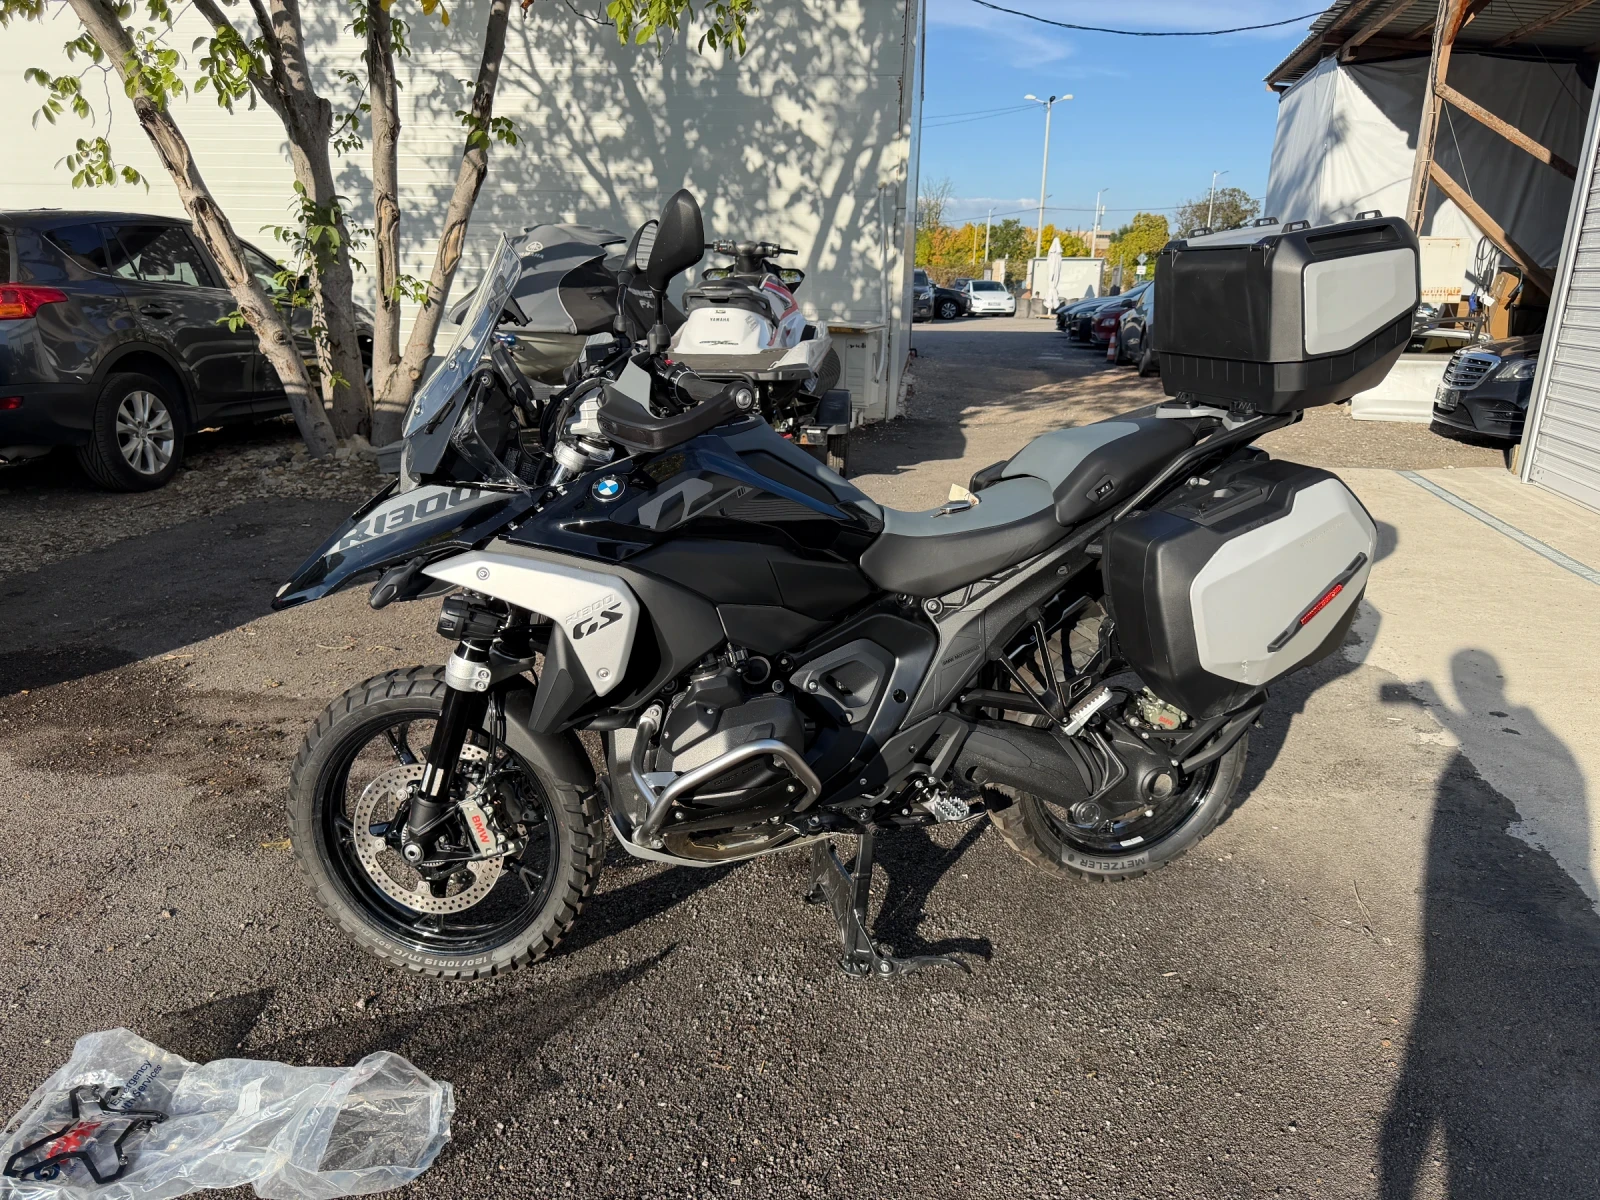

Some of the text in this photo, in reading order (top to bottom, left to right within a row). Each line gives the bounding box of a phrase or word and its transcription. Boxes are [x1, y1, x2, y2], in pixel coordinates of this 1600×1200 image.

[338, 487, 482, 551] R1300
[565, 593, 615, 625] R1300
[573, 601, 624, 640] GS
[472, 815, 490, 843] BMW
[1080, 857, 1146, 871] METZELER
[132, 1064, 162, 1097] Services
